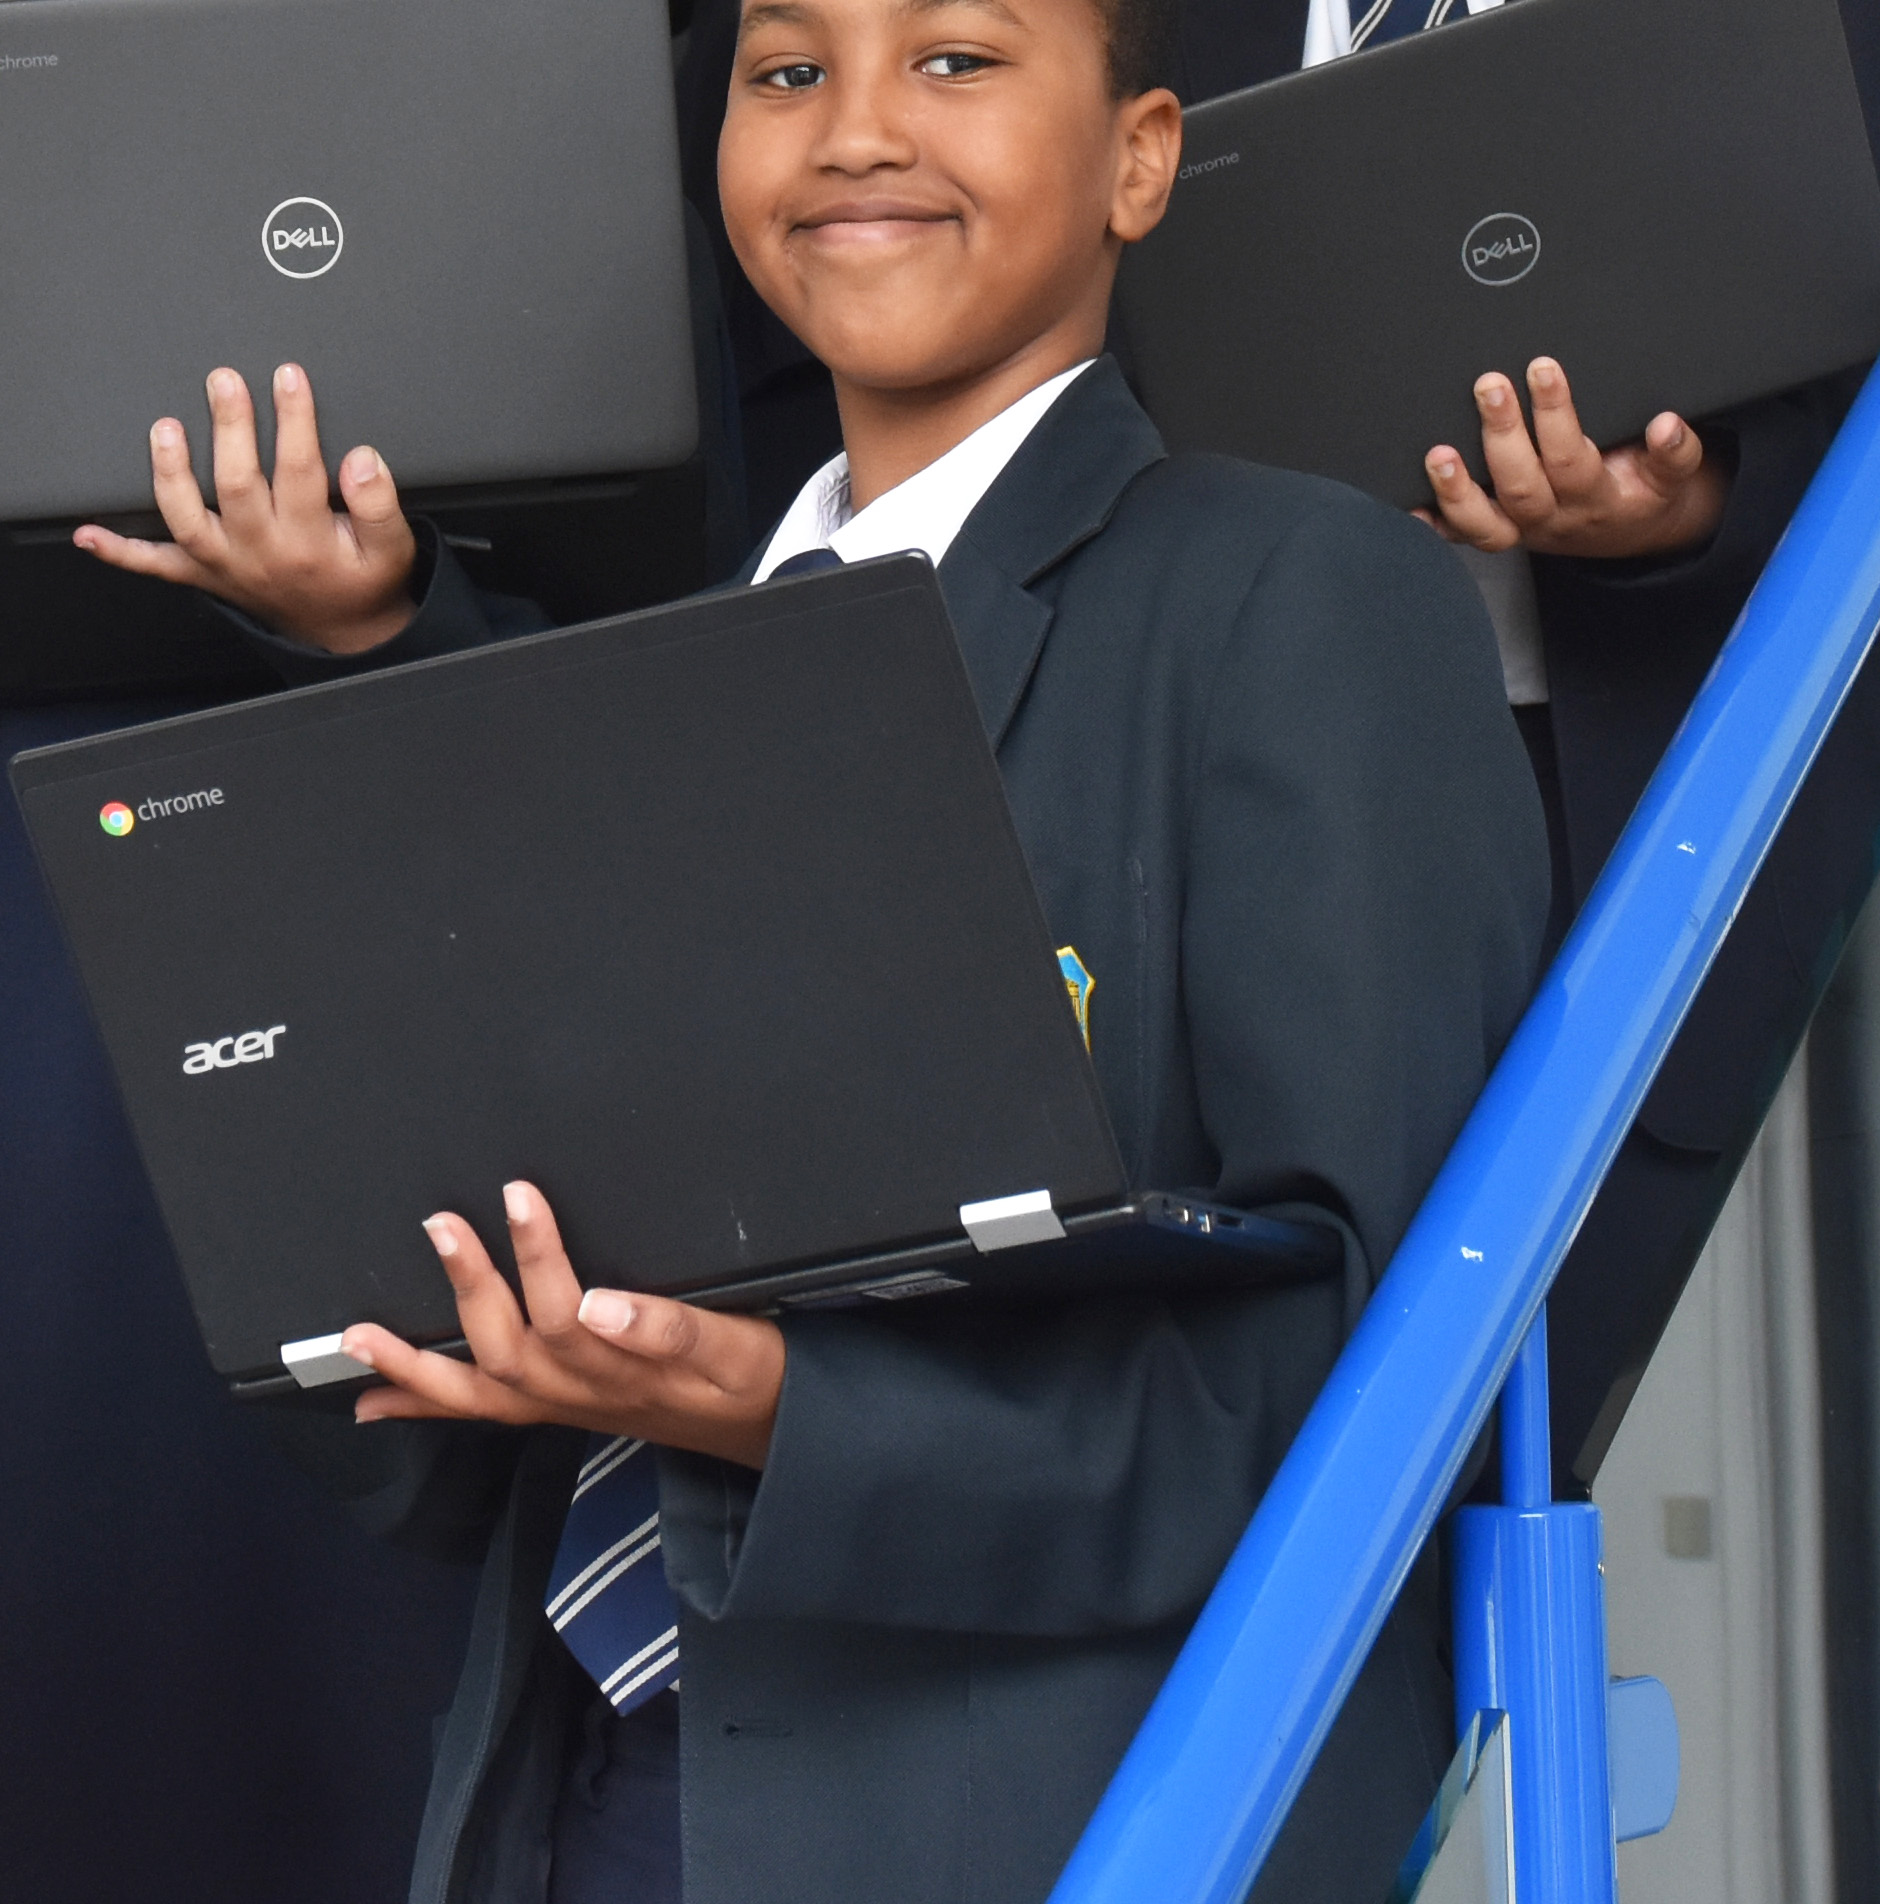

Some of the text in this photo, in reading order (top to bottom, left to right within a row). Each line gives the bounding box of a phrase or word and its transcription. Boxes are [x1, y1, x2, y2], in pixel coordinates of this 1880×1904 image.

[1179, 152, 1240, 179] chrome
[273, 226, 336, 251] DELL
[1472, 233, 1534, 266] DELL
[137, 788, 225, 821] chrome
[182, 1024, 287, 1075] acer
